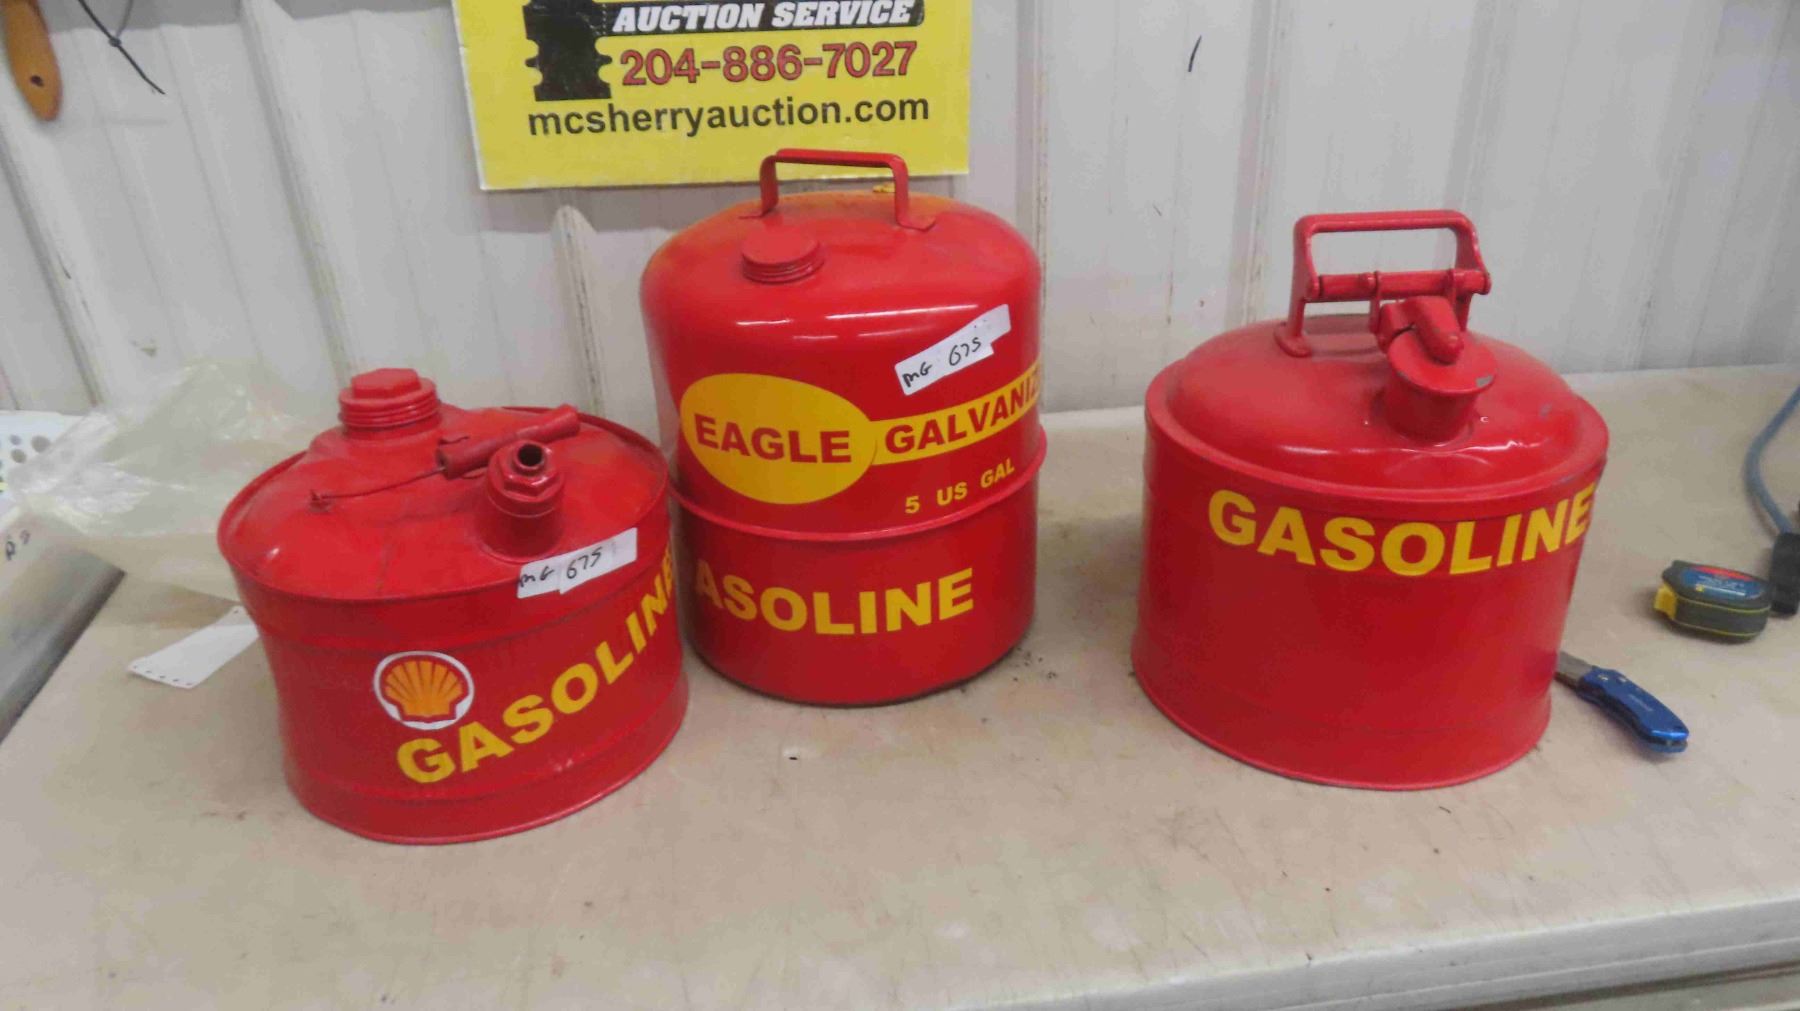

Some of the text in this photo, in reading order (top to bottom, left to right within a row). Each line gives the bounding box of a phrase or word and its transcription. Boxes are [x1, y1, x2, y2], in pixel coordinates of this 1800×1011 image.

[612, 0, 913, 32] AUCTION SERVICE
[620, 41, 917, 86] 204-886-7027
[528, 96, 930, 137] mcsherryauction.com
[694, 413, 852, 463] EAGLE
[905, 458, 1015, 514] 5 US GAL
[1208, 482, 1596, 576] GASOLINE
[566, 547, 602, 579] 675
